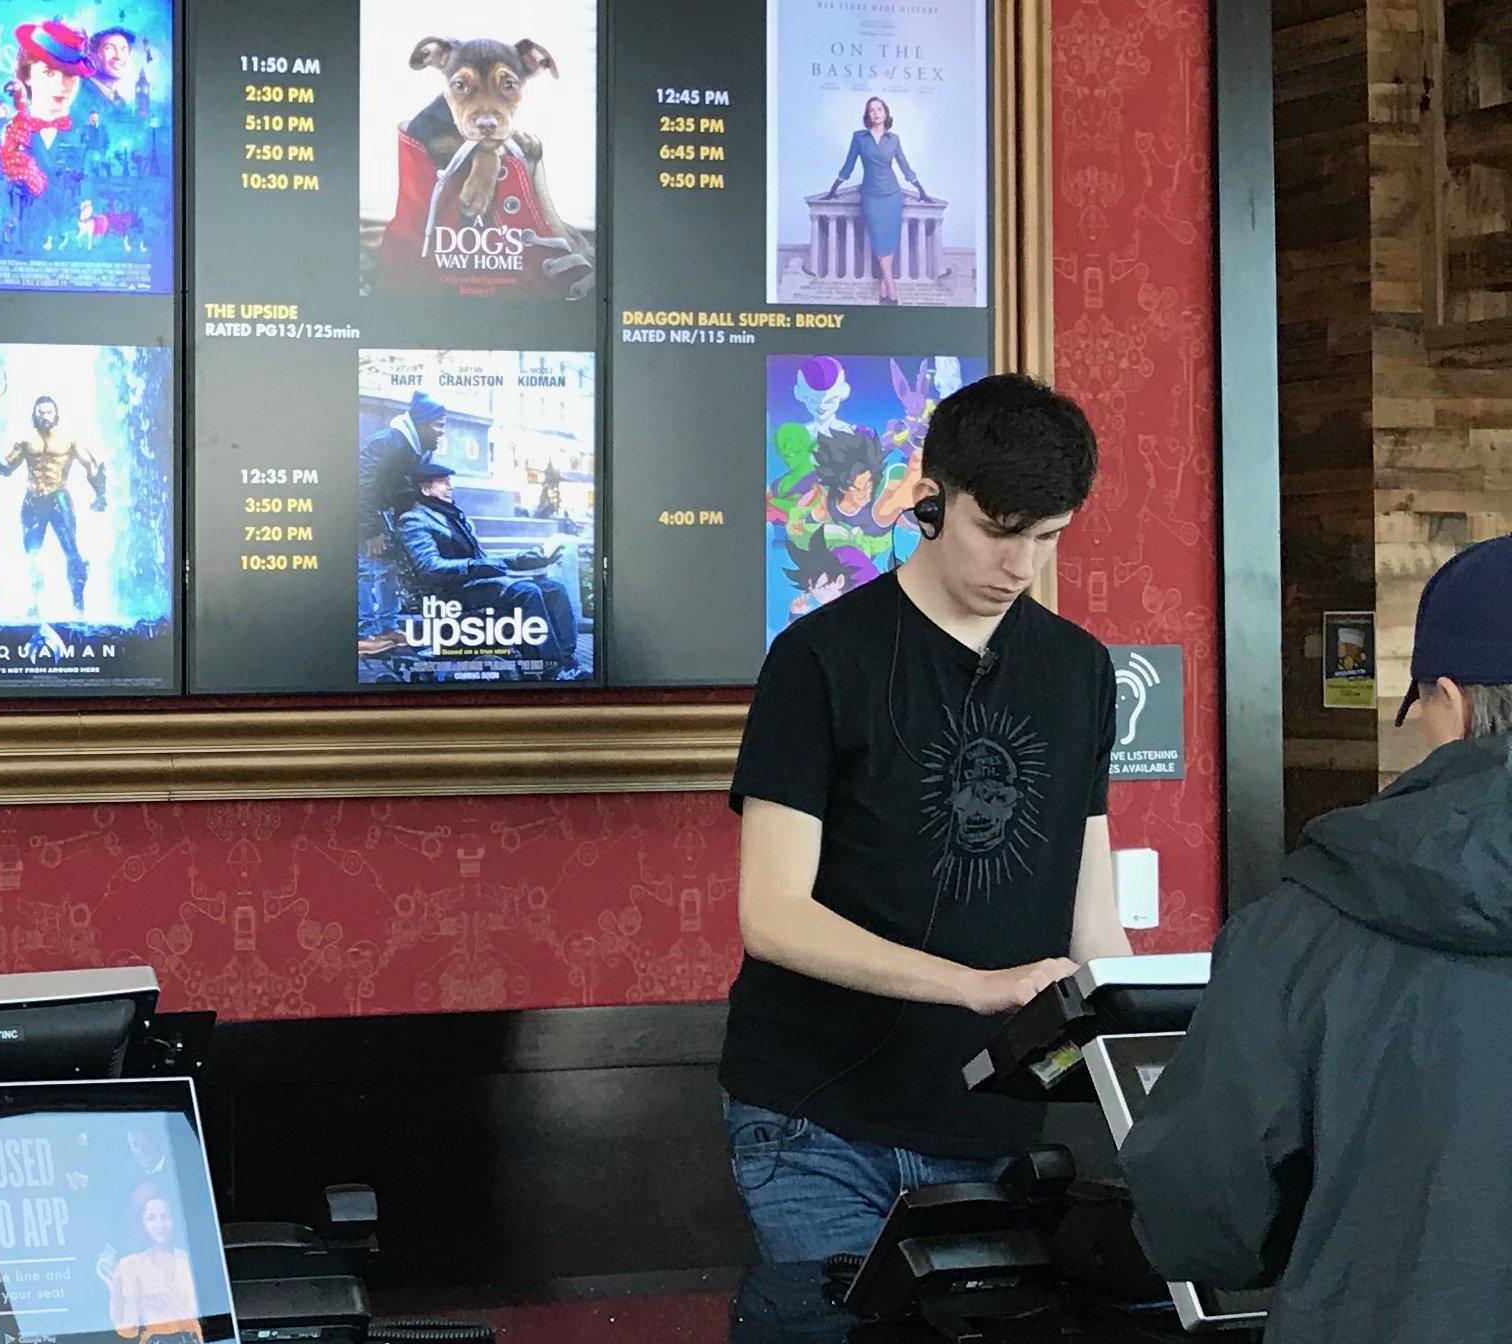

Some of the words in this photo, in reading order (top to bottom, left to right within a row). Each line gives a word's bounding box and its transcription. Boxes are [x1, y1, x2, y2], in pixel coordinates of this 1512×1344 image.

[830, 42, 863, 57] ON
[878, 44, 924, 59] THE
[240, 56, 288, 73] 11:50
[292, 58, 320, 74] AM
[812, 62, 878, 78] BASIS
[903, 67, 944, 81] SEX
[245, 86, 284, 102] 2:30
[289, 88, 314, 103] PM
[657, 89, 700, 105] 12:45
[705, 90, 729, 106] PM
[245, 115, 283, 131] 5:10
[289, 117, 314, 132] PM
[660, 117, 695, 132] 2:35
[700, 118, 724, 133] PM
[245, 145, 284, 160] 7:50
[289, 146, 313, 161] PM
[660, 145, 695, 160] 6:45
[700, 146, 724, 161] PM
[241, 174, 288, 189] 10:30
[293, 175, 319, 190] PM
[660, 173, 695, 188] 9:50
[700, 174, 724, 188] PM
[435, 225, 523, 255] DOG'S
[435, 254, 469, 268] WAY
[474, 255, 523, 270] HOME
[205, 304, 235, 319] THE
[241, 304, 298, 320] UPSIDE
[623, 312, 693, 327] DRAGON
[698, 313, 734, 327] BALL
[739, 313, 791, 328] SUPER:
[796, 314, 844, 329] BROLY
[205, 323, 251, 337] RATED
[256, 324, 359, 340] PG13/125min
[623, 330, 665, 343] RATED
[670, 331, 725, 344] NR/115
[729, 332, 755, 344] min
[390, 374, 423, 385] HART
[438, 375, 503, 386] CRANSTON
[518, 376, 566, 387] KIDMAN
[241, 469, 288, 484] 12:35
[293, 470, 318, 484] PM
[245, 498, 283, 513] 3:50
[288, 499, 313, 512] PM
[659, 511, 694, 525] 4:00
[699, 511, 723, 525] PM
[245, 527, 283, 541] 7:20
[288, 527, 313, 541] PM
[241, 555, 288, 570] 10:30
[293, 555, 318, 569] PM
[422, 595, 461, 619] the
[405, 608, 548, 655] upside
[1127, 750, 1178, 760] LISTENING
[1122, 763, 1175, 773] AVAILABLE
[24, 1197, 70, 1247] APP
[15, 1269, 41, 1283] line
[46, 1267, 71, 1282] and
[1, 1288, 31, 1304] your
